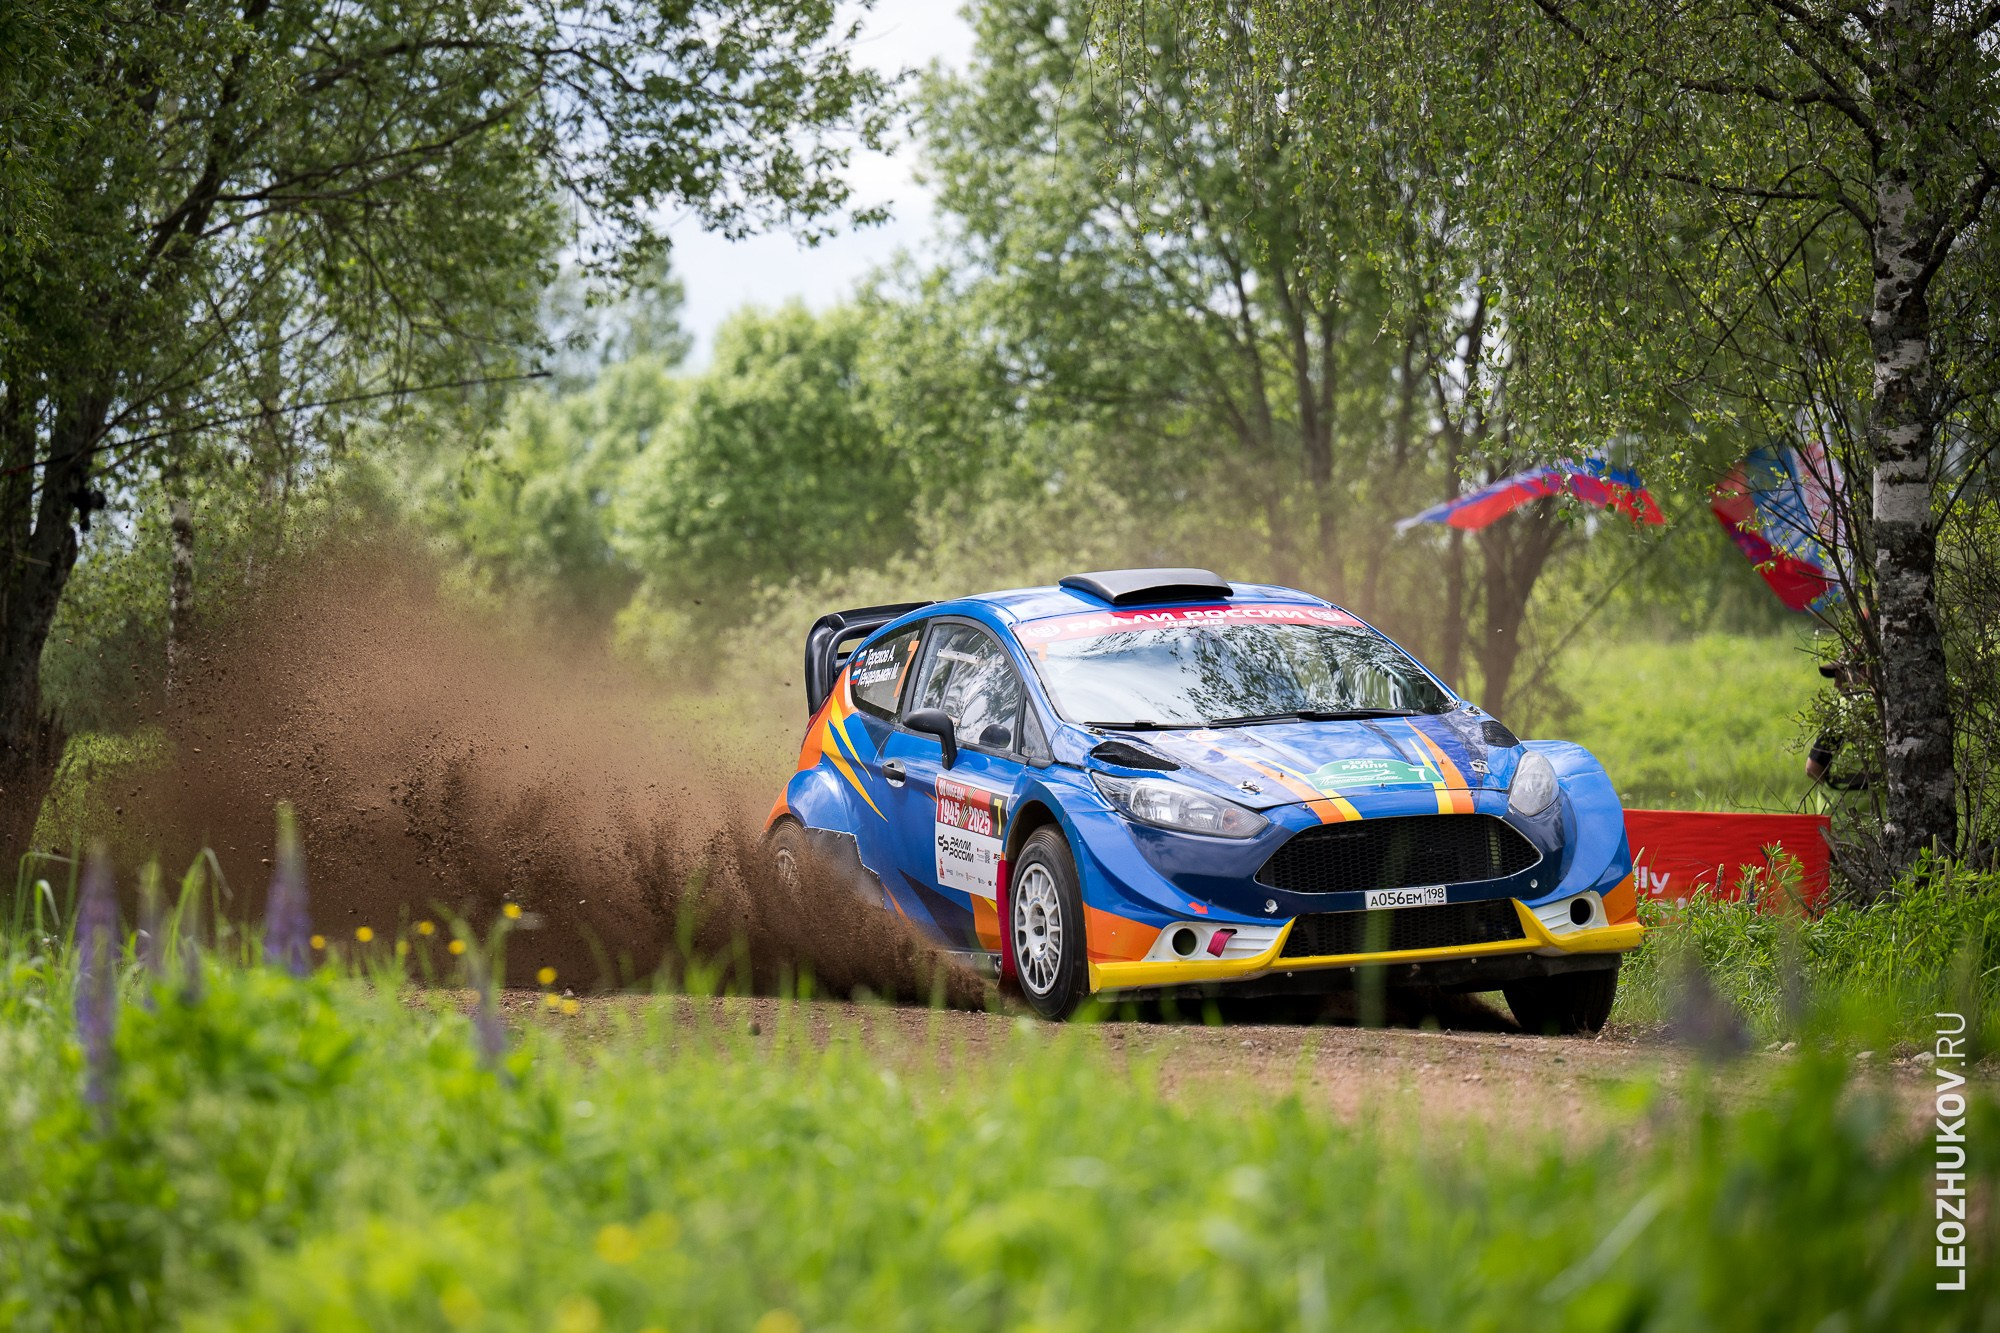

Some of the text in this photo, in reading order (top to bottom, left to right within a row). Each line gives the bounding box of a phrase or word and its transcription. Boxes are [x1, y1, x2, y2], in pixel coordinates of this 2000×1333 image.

[1066, 609, 1306, 632] РАЛЛИ РОССИИ
[893, 641, 920, 698] 7
[1408, 768, 1427, 781] 7
[940, 798, 991, 836] 1945 2025
[993, 798, 1003, 836] 7
[949, 848, 974, 863] РОССИИ
[1370, 888, 1444, 907] А056ЕМ 198
